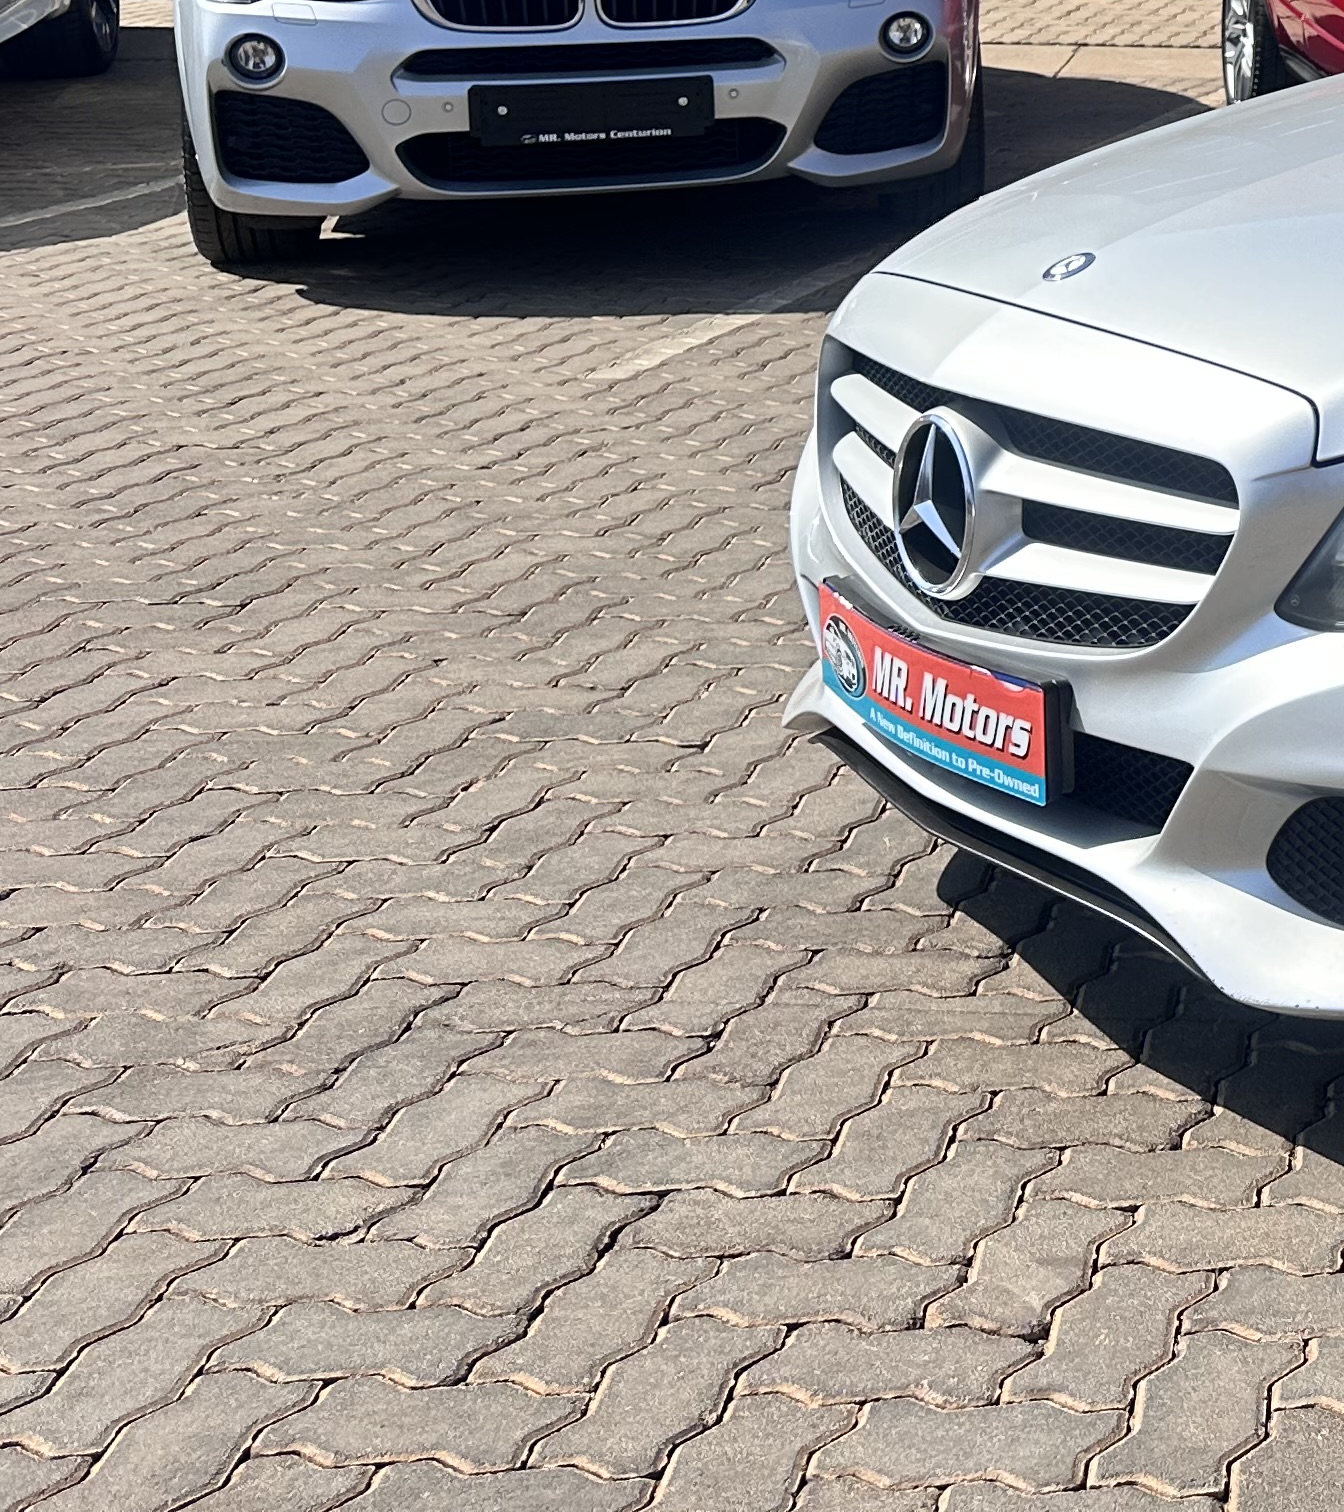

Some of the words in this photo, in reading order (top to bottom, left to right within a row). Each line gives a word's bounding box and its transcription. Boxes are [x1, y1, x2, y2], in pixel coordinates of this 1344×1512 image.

[538, 133, 561, 143] MR.
[564, 132, 606, 141] Motors
[609, 128, 672, 139] Centurion
[871, 645, 913, 713] MR.
[918, 671, 1033, 760] Motors
[869, 706, 877, 721] A
[877, 713, 896, 735] New
[897, 723, 950, 763] Definition
[952, 753, 966, 771] to
[968, 759, 1040, 799] Pre-Owned
